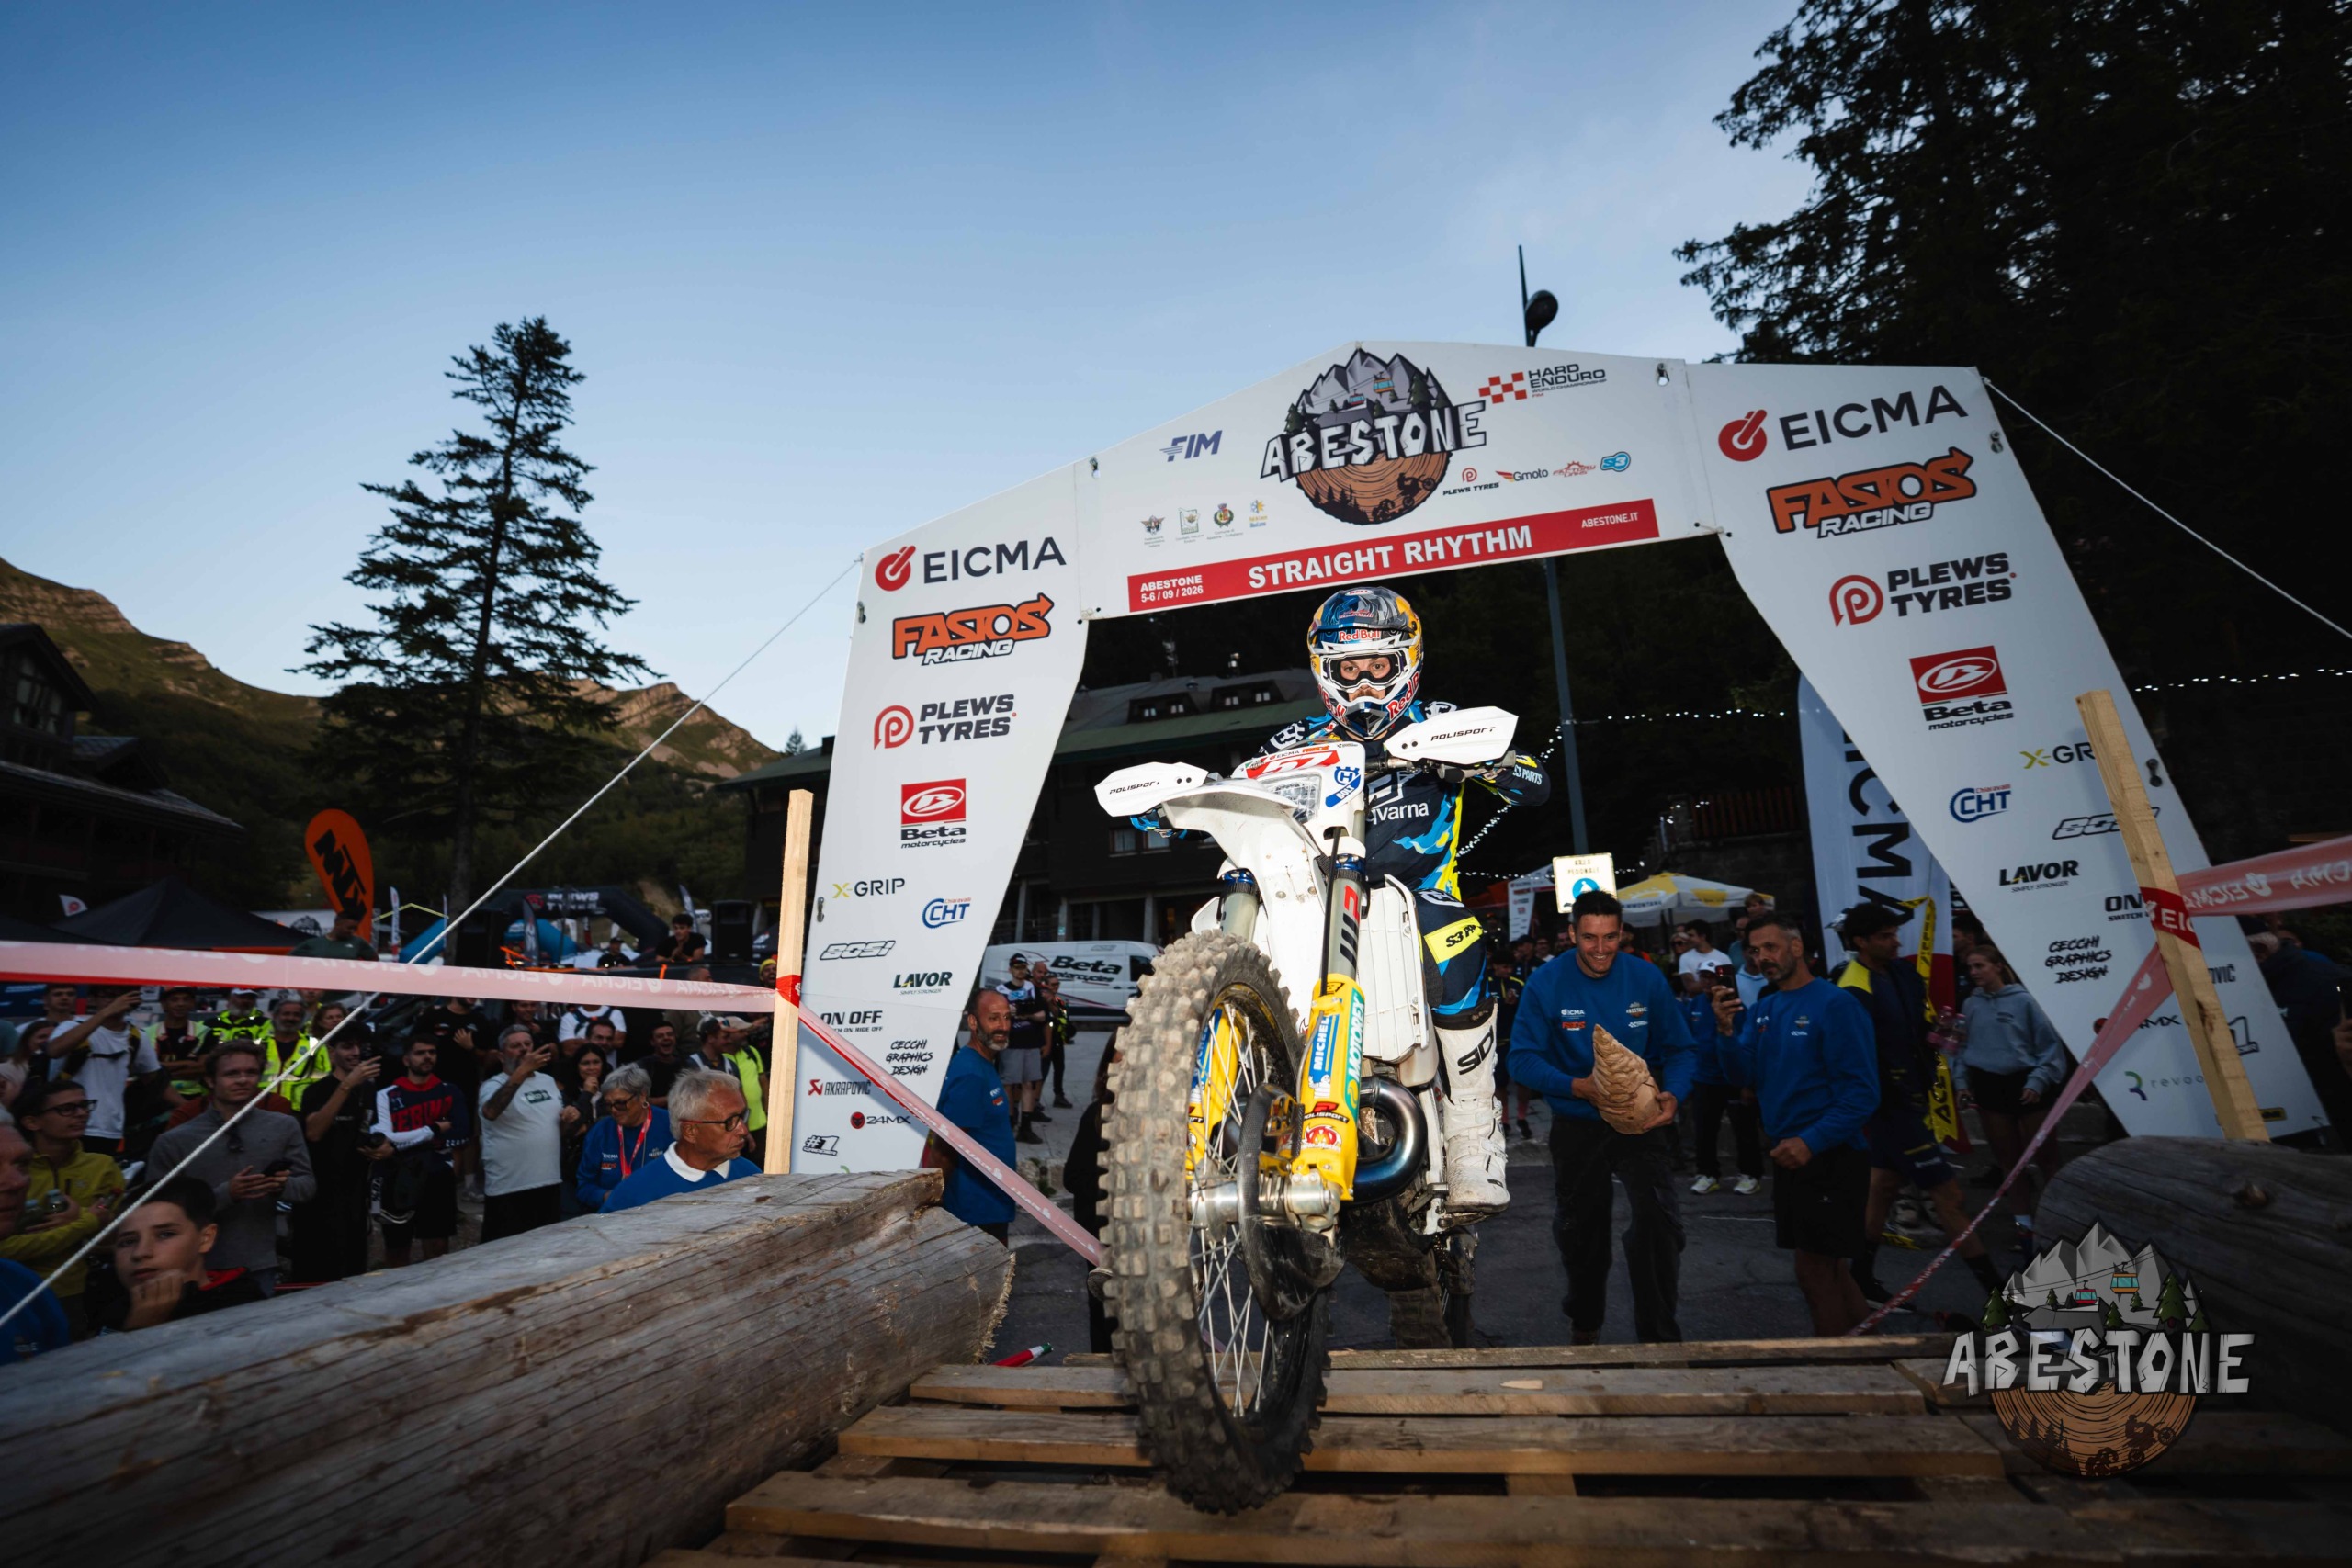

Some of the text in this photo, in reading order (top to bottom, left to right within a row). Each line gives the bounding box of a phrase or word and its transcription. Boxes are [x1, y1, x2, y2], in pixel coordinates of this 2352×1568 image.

[1528, 363, 1579, 379] HARD
[1530, 369, 1606, 389] ENDURO
[1779, 384, 1968, 451] EICMA
[1159, 430, 1223, 462] FIM
[1261, 400, 1487, 482] ABESTONE
[1513, 468, 1548, 481] Gmoto
[1443, 482, 1499, 495] PLEWS TYRES
[1581, 513, 1639, 528] ABESTONE.IT
[1817, 502, 1933, 538] RACING
[923, 536, 1067, 584] EICMA
[1249, 525, 1532, 589] STRAIGHT RHYTHM
[1887, 552, 2009, 592] PLEWS
[1140, 575, 1202, 592] ABESTONE
[1890, 578, 2012, 617] TYRES
[1340, 628, 1381, 641] Red Bull
[922, 639, 1014, 665] RACING
[920, 694, 1014, 722] PLEWS
[1923, 697, 2012, 721] Beta
[919, 716, 1011, 744] TYRES
[1928, 712, 2014, 730] motorcycles
[1276, 750, 1300, 758] EICMA
[2019, 742, 2096, 770] X-GR
[1522, 768, 1543, 785] PARTS
[1336, 786, 1356, 800] BOLT
[1960, 790, 2011, 815] CHT
[900, 826, 967, 840] Beta
[901, 838, 966, 849] motorcycles
[1999, 860, 2079, 886] LAVOR
[832, 878, 905, 898] X-GRIP
[930, 903, 970, 921] CHT
[2105, 893, 2142, 912] ON
[1446, 930, 1464, 948] S3
[1050, 956, 1122, 975] Beta
[2045, 950, 2112, 969] GRAPHICS
[893, 971, 953, 988] LAVOR
[2054, 965, 2109, 984] DESIGN
[820, 1010, 883, 1025] ON OFF
[1313, 1016, 1329, 1071] MICHEL
[1348, 999, 1364, 1081] MOTOREX
[886, 1052, 933, 1063] GRAPHICS
[891, 1064, 928, 1076] DESIGN
[824, 1080, 871, 1095] AKRAPOVIČ
[866, 1115, 911, 1124] 24MX
